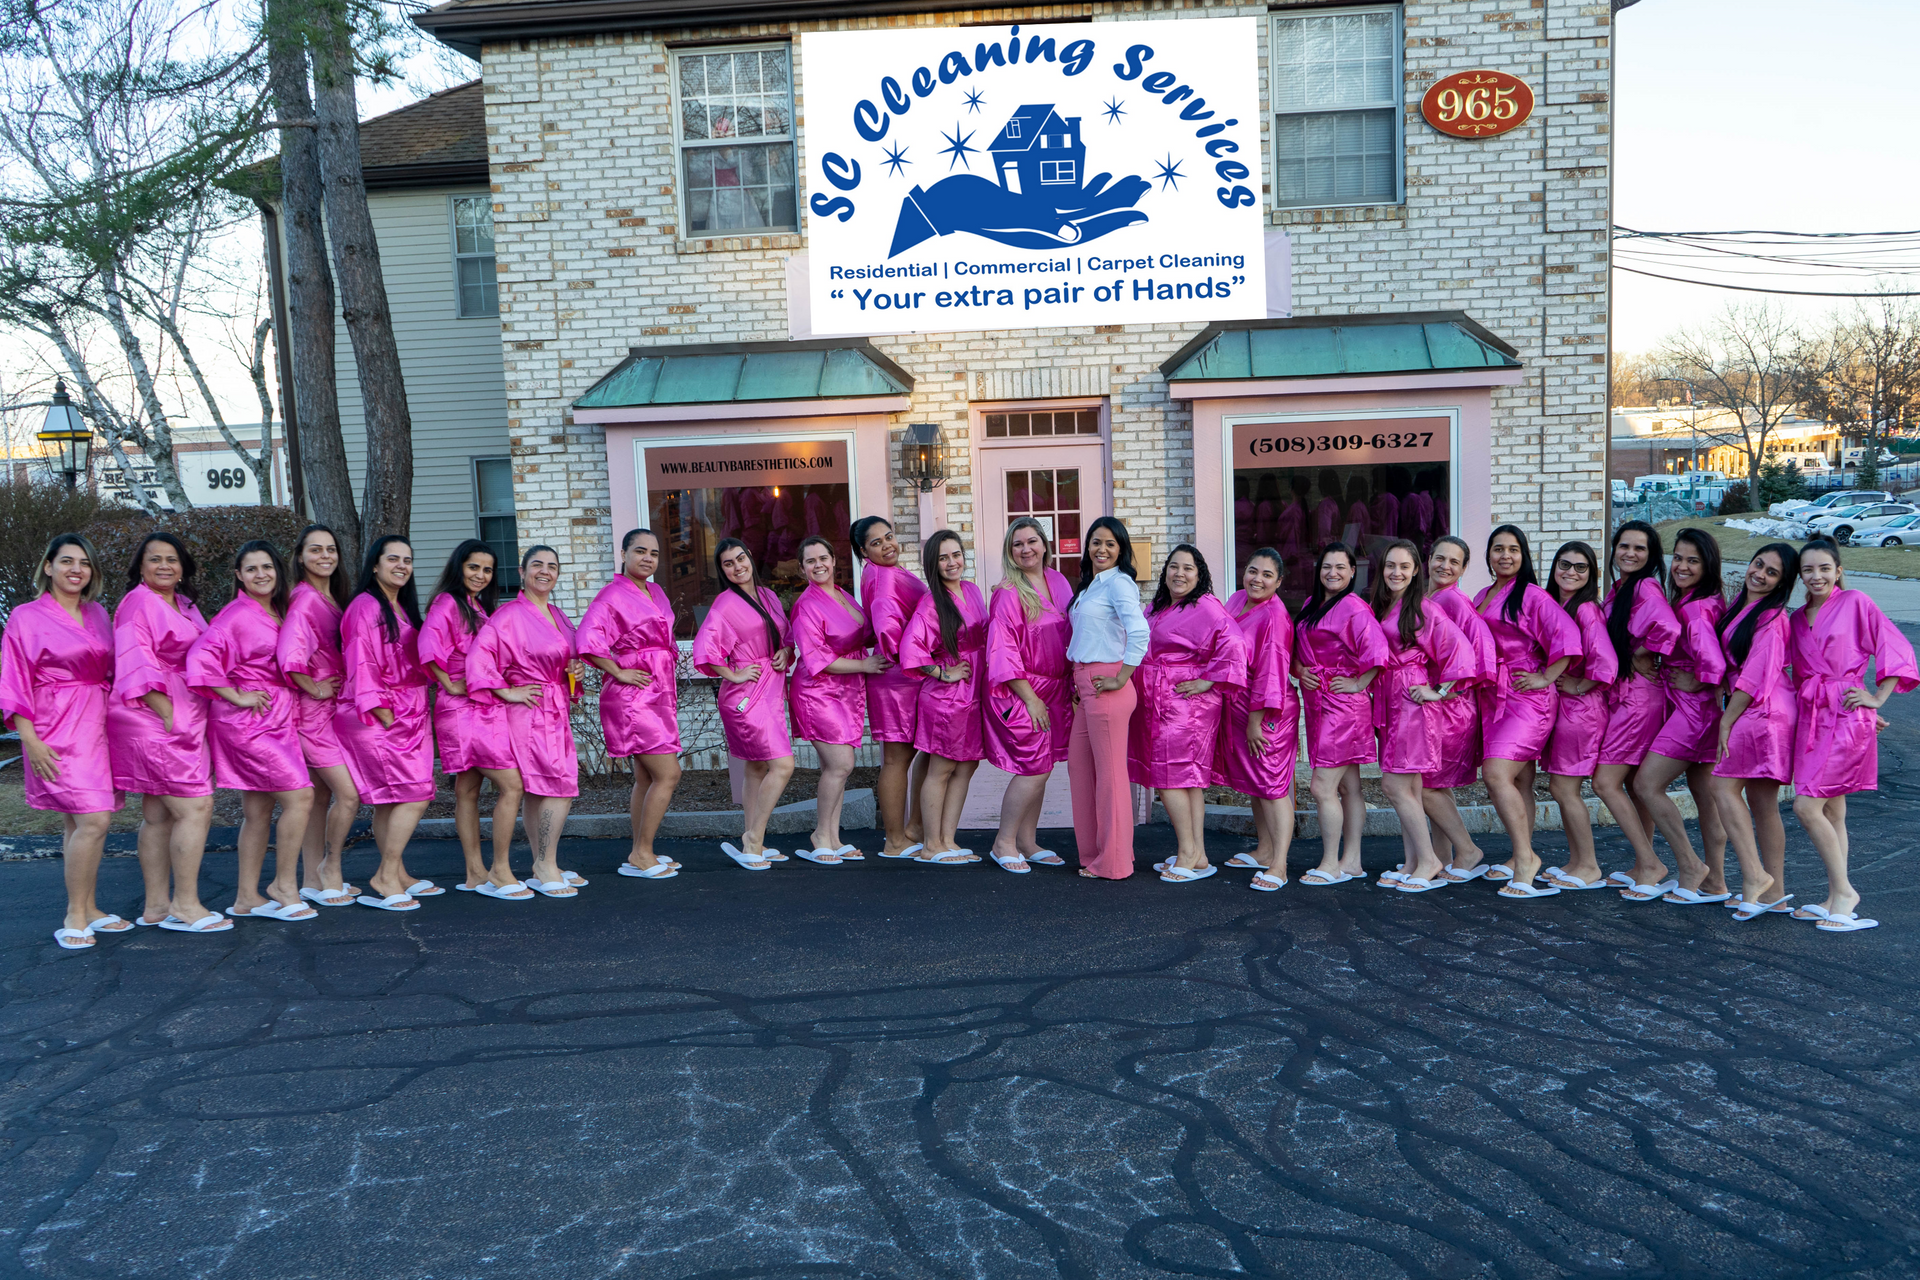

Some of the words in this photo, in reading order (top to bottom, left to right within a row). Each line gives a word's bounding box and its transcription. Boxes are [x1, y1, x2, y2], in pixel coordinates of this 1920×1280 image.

[1437, 85, 1519, 121] 965
[811, 152, 861, 223] SC
[853, 25, 1095, 142] Cleaning
[1113, 45, 1255, 209] Services
[830, 262, 938, 280] Residential
[954, 258, 1071, 276] Commercial
[1087, 255, 1155, 273] Carpet
[1159, 252, 1245, 269] Cleaning
[935, 285, 1014, 308] extra
[1024, 281, 1085, 311] pair
[1093, 279, 1125, 302] of
[1250, 432, 1434, 457] (508)309-6327
[207, 467, 246, 489] 969
[660, 456, 833, 475] WWW.BEAUTYBARESTHETICS.COM
